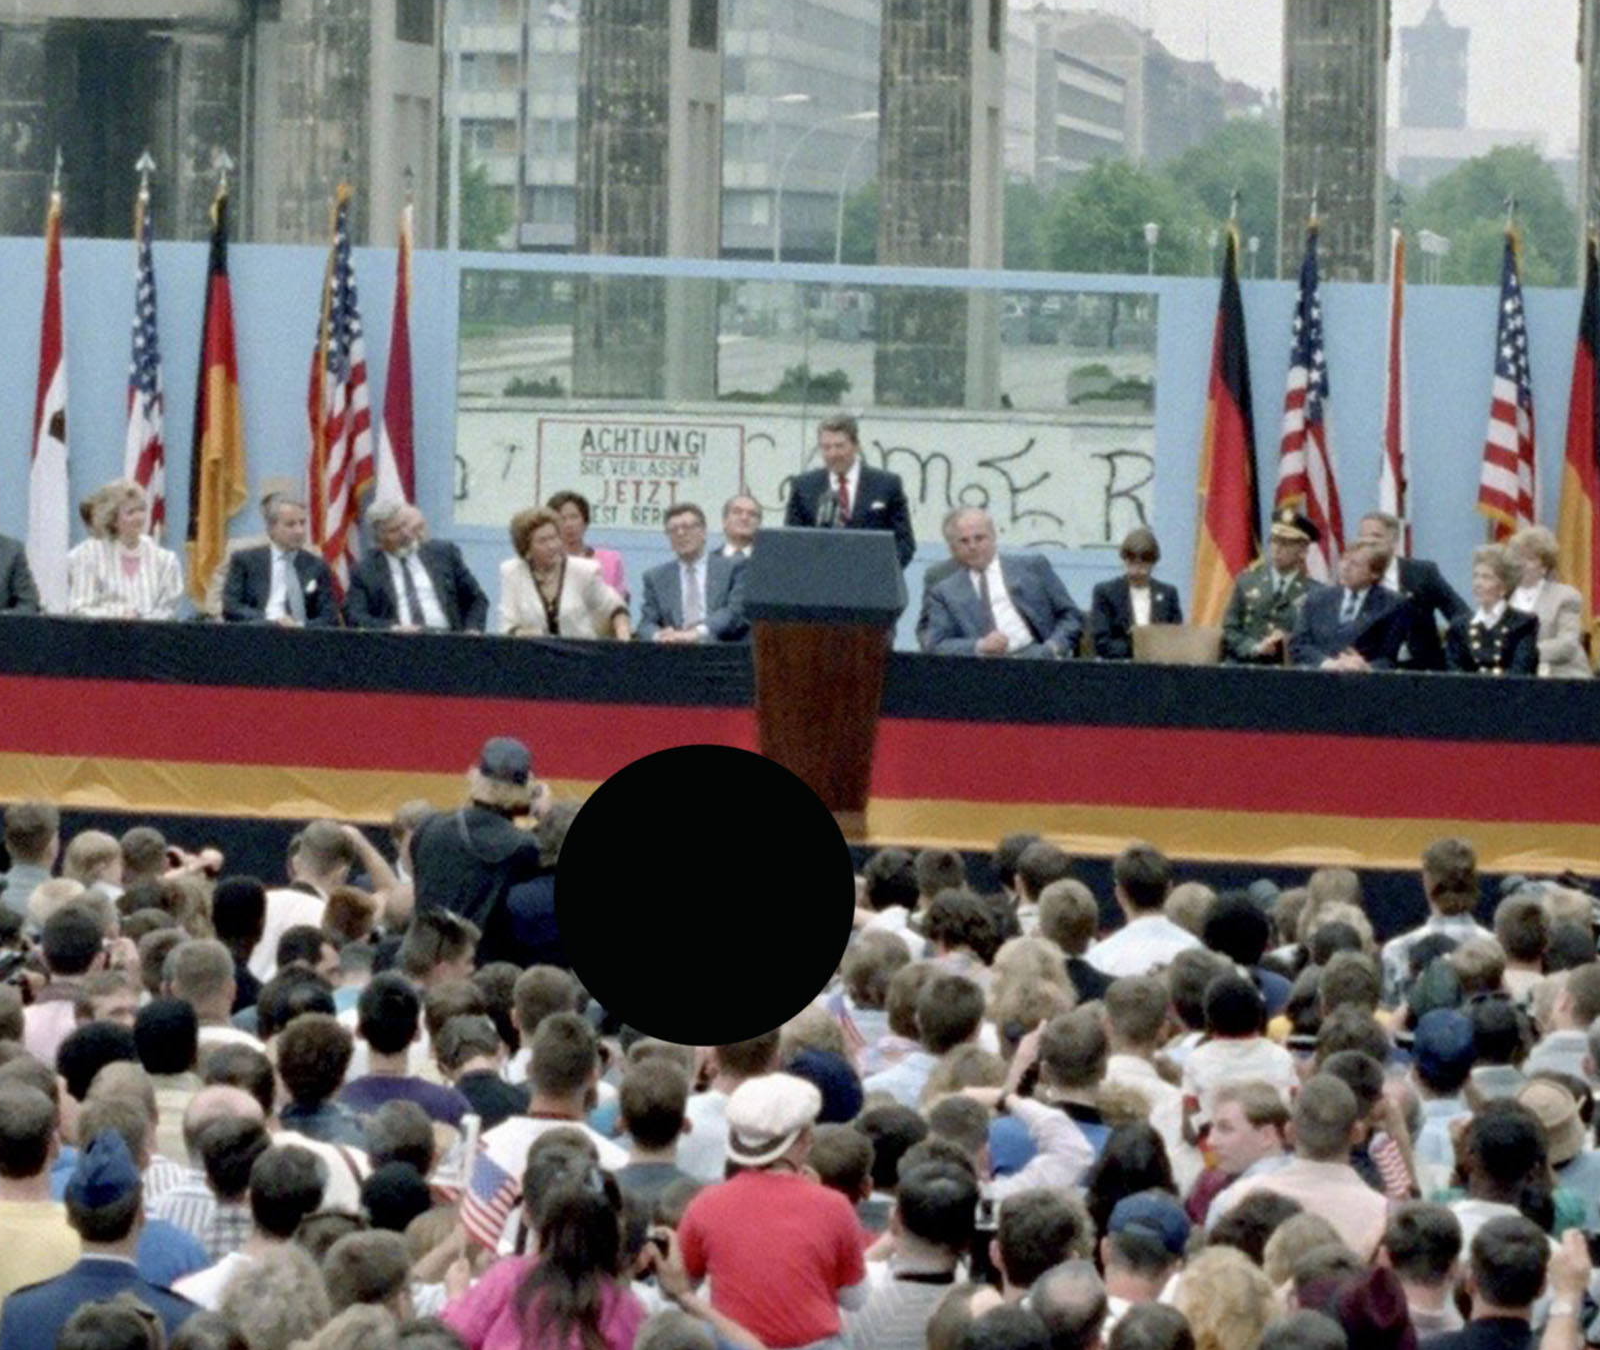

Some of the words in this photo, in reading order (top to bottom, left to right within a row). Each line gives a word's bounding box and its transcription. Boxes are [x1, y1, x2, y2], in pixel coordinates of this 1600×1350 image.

[580, 427, 707, 457] ACHTUNG!
[580, 458, 604, 476] SIE
[610, 459, 700, 479] VERLASSEN
[600, 480, 680, 505] JETZT
[591, 505, 618, 524] EST
